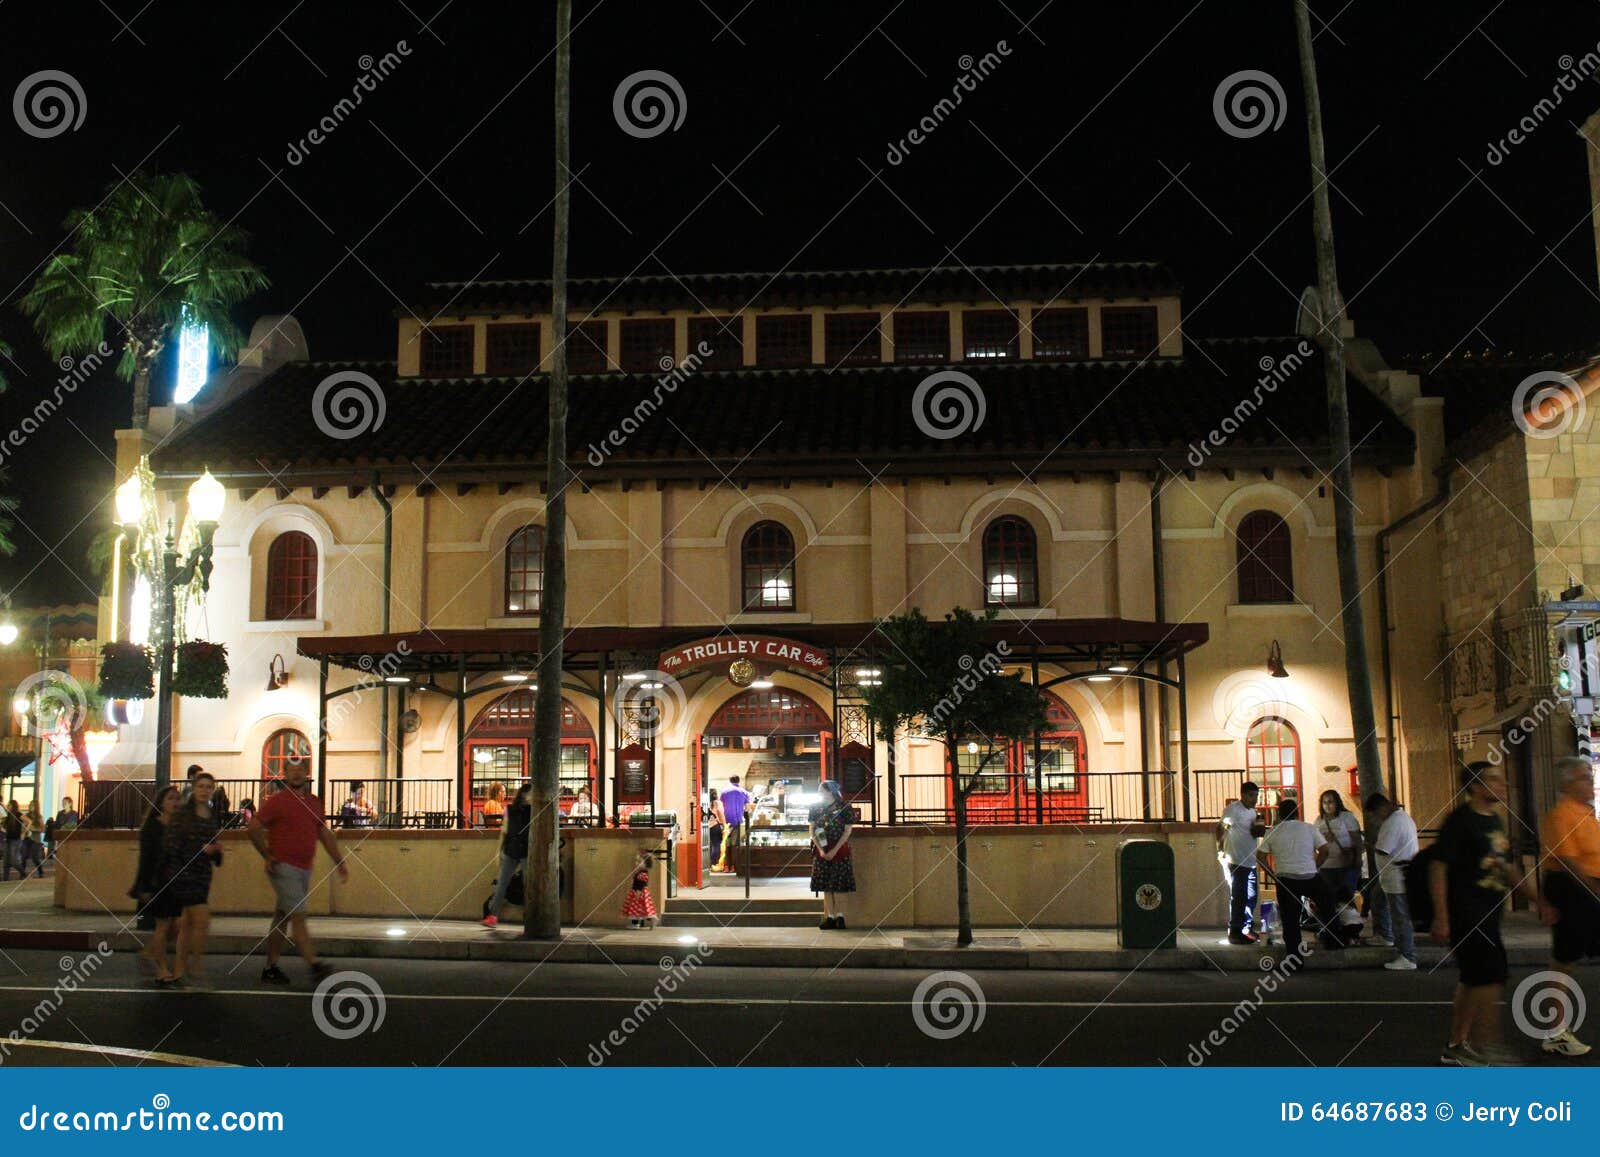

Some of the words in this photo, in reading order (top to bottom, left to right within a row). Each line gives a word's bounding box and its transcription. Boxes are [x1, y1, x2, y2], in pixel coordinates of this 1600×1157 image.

[663, 655, 682, 669] The
[682, 640, 760, 662] TROLLEY
[766, 642, 802, 661] CAR
